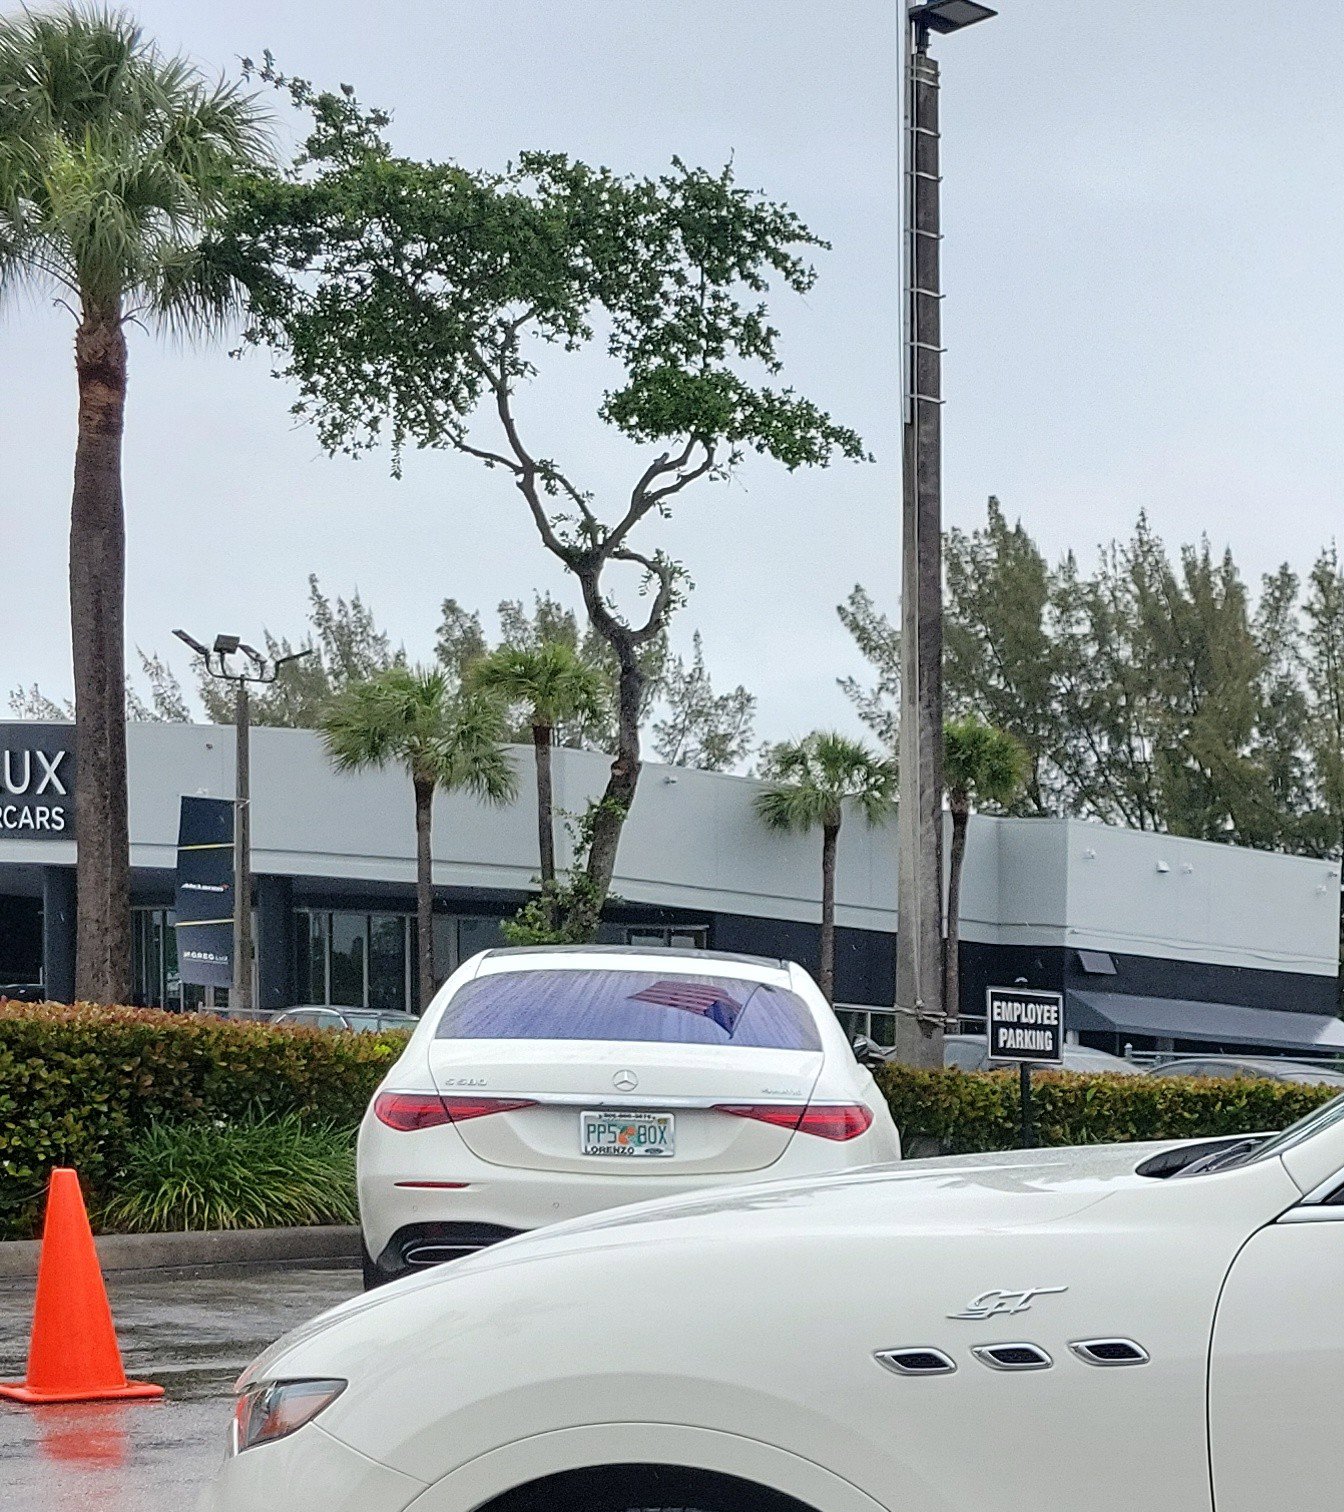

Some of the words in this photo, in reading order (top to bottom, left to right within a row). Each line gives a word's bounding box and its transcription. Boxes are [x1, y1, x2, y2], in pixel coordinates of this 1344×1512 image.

[4, 750, 67, 795] UX
[0, 805, 65, 831] CARS
[993, 1001, 1058, 1025] EMPLOYEE
[998, 1028, 1053, 1050] PARKING
[584, 1145, 635, 1155] LORENZO
